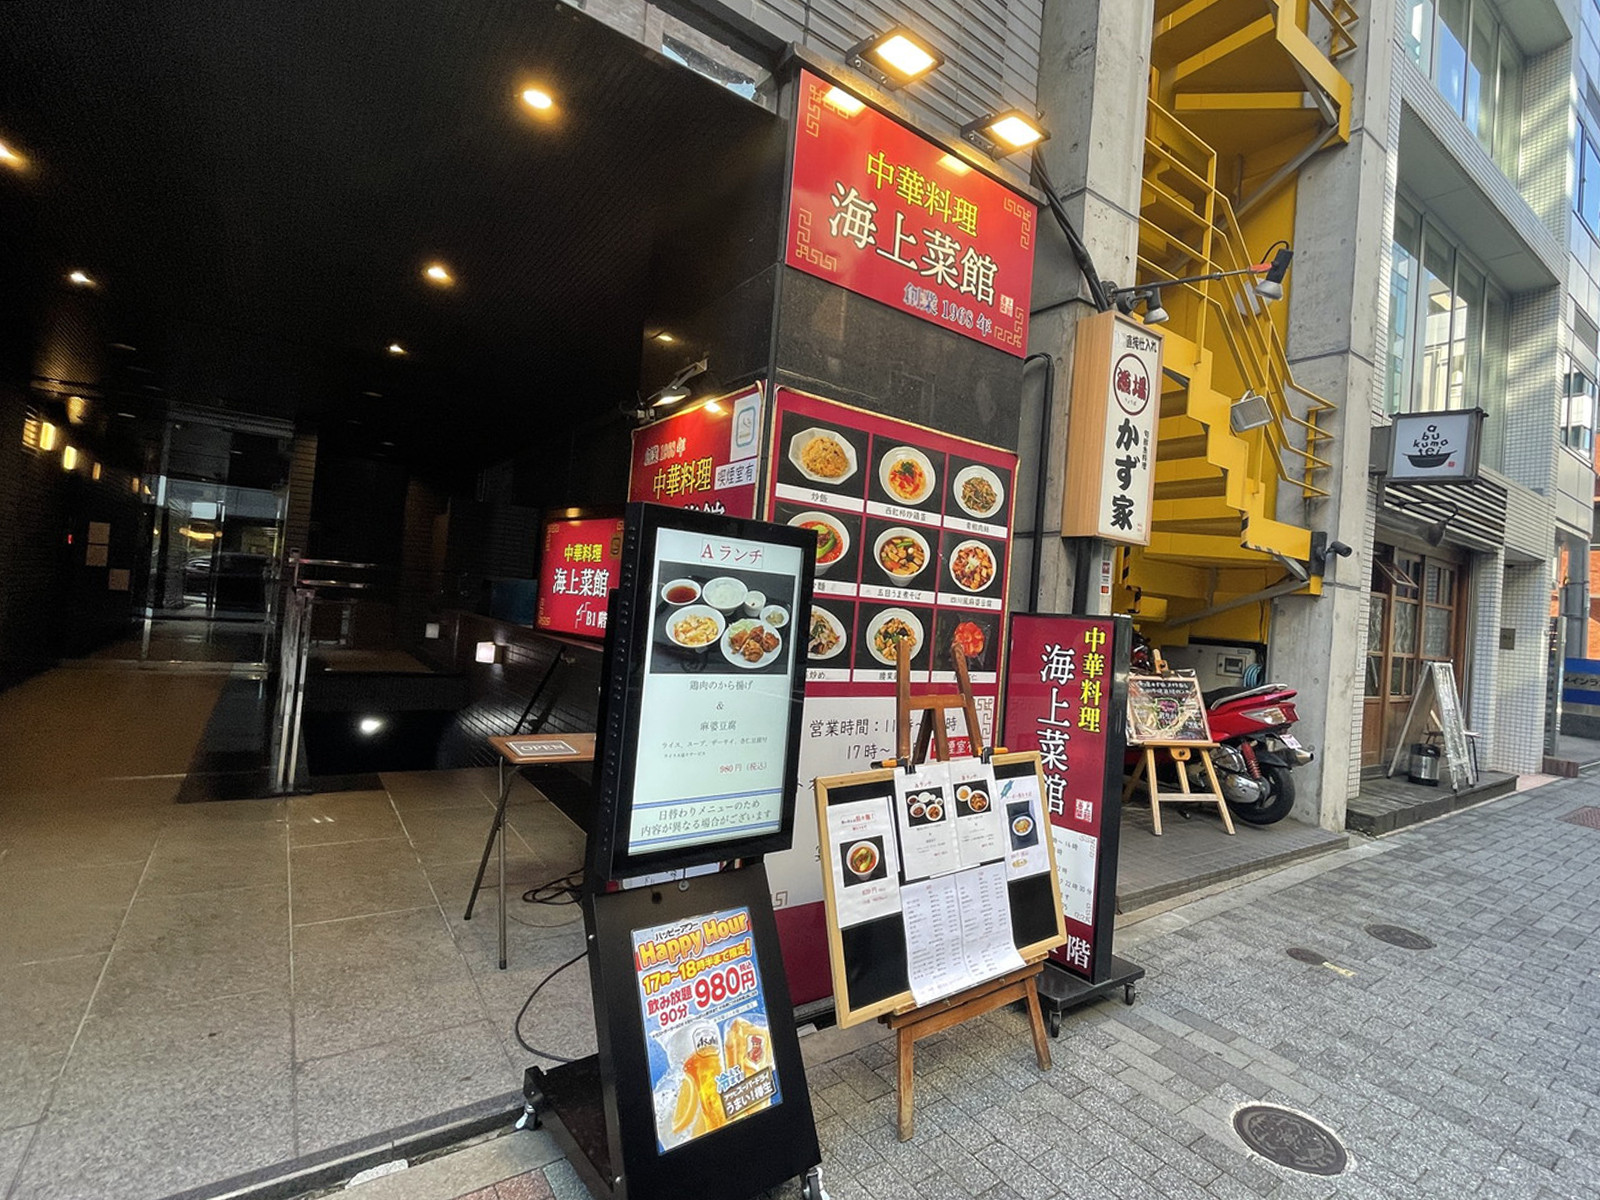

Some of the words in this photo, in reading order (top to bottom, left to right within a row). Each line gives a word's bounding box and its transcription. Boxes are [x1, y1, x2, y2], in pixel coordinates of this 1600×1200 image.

[866, 151, 978, 237] 中華料理
[829, 182, 999, 306] 海上菜館
[942, 301, 974, 329] 1968
[1421, 432, 1440, 441] bu
[1427, 424, 1437, 433] a
[1412, 438, 1449, 449] kuma
[1418, 447, 1442, 456] tei
[653, 456, 714, 500] 中華料理
[1110, 417, 1140, 531] かず家
[810, 491, 828, 503] 炒飯
[564, 543, 603, 564] 中華料理
[552, 567, 610, 597] 海上菜館
[689, 679, 754, 691] 鶏肉のから揚げ
[1077, 626, 1106, 733] 中華料理
[700, 719, 737, 732] 麻婆豆腐
[1036, 644, 1076, 816] 海上菜館
[520, 742, 566, 752] OPEN
[640, 809, 772, 837] 内容が異なる場合がございます
[659, 799, 761, 822] 日替わりメニューのため
[638, 929, 702, 968] Happy
[701, 911, 750, 944] Hour
[654, 922, 699, 942] ハッピーアワー
[1066, 934, 1091, 970] 階
[647, 985, 693, 1016] 飲み放題
[694, 967, 756, 1008] 980円
[659, 1004, 688, 1027] 90分
